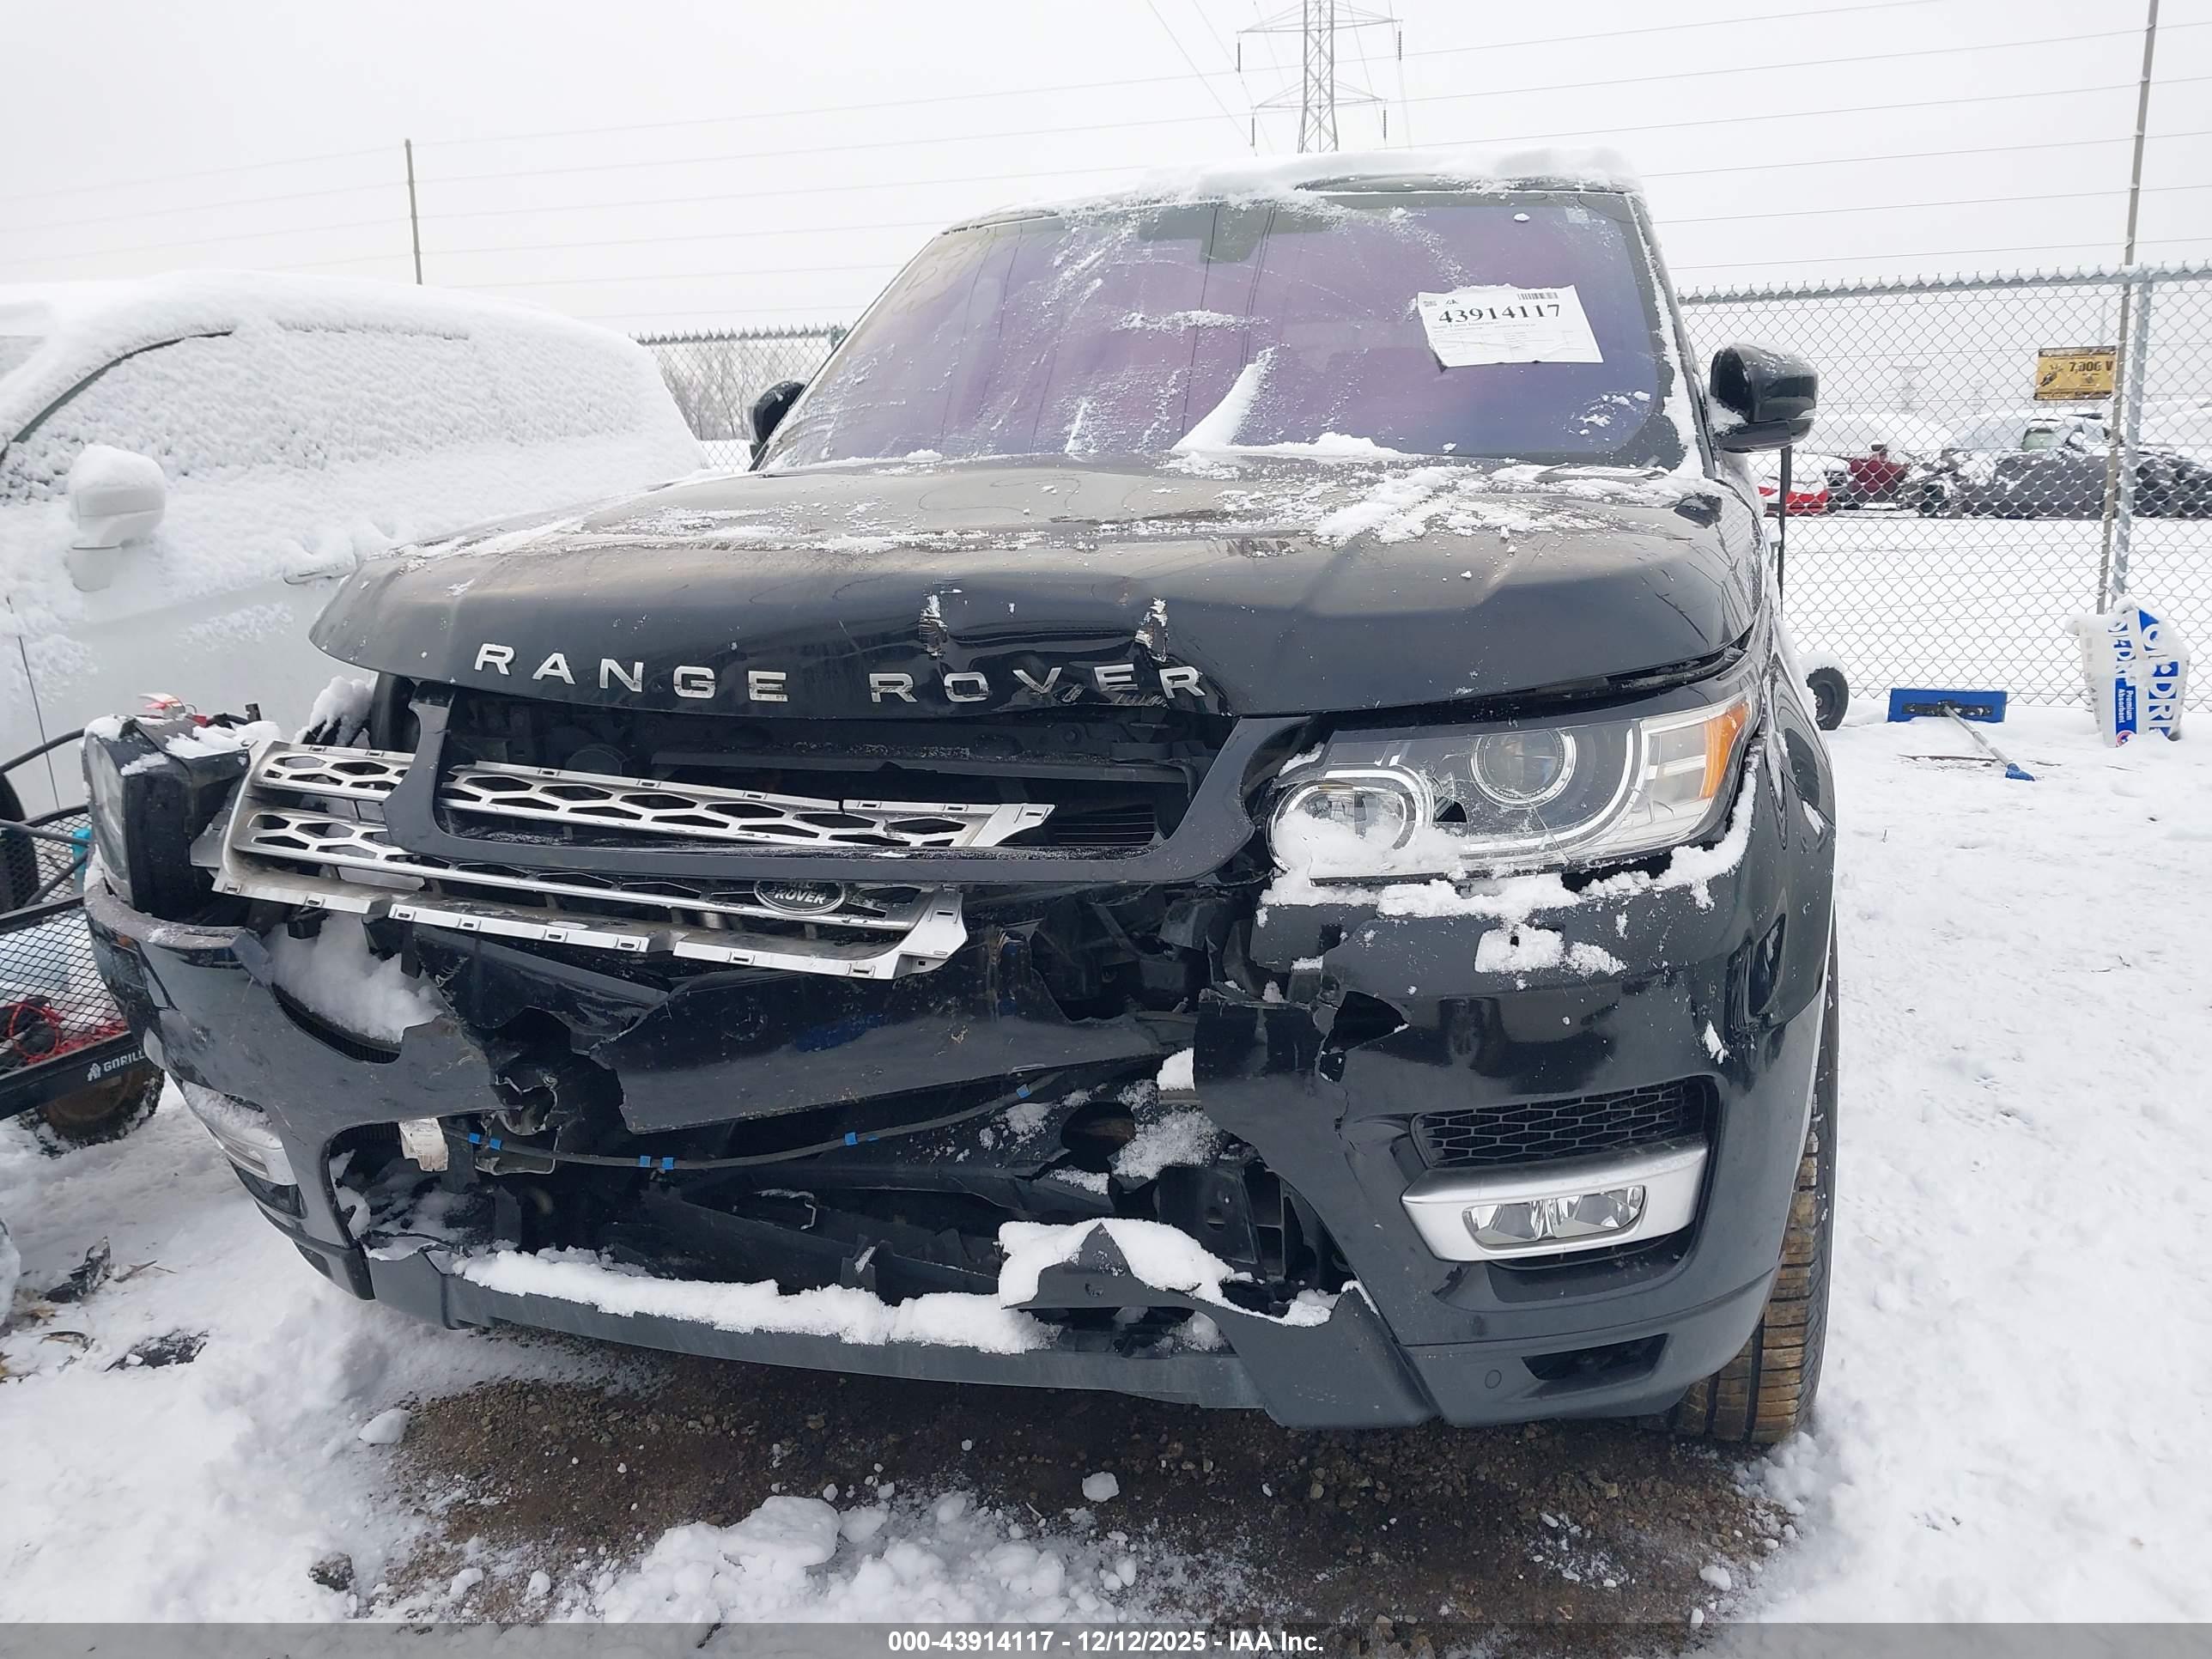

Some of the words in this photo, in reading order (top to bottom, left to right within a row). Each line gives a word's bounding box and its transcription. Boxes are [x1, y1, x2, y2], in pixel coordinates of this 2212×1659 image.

[1439, 304, 1560, 323] 43914117
[474, 643, 788, 702] RANGE
[869, 664, 1206, 702] ROVER
[2126, 690, 2135, 720] Premium
[774, 889, 827, 904] ROVER
[103, 1050, 146, 1073] GORILL
